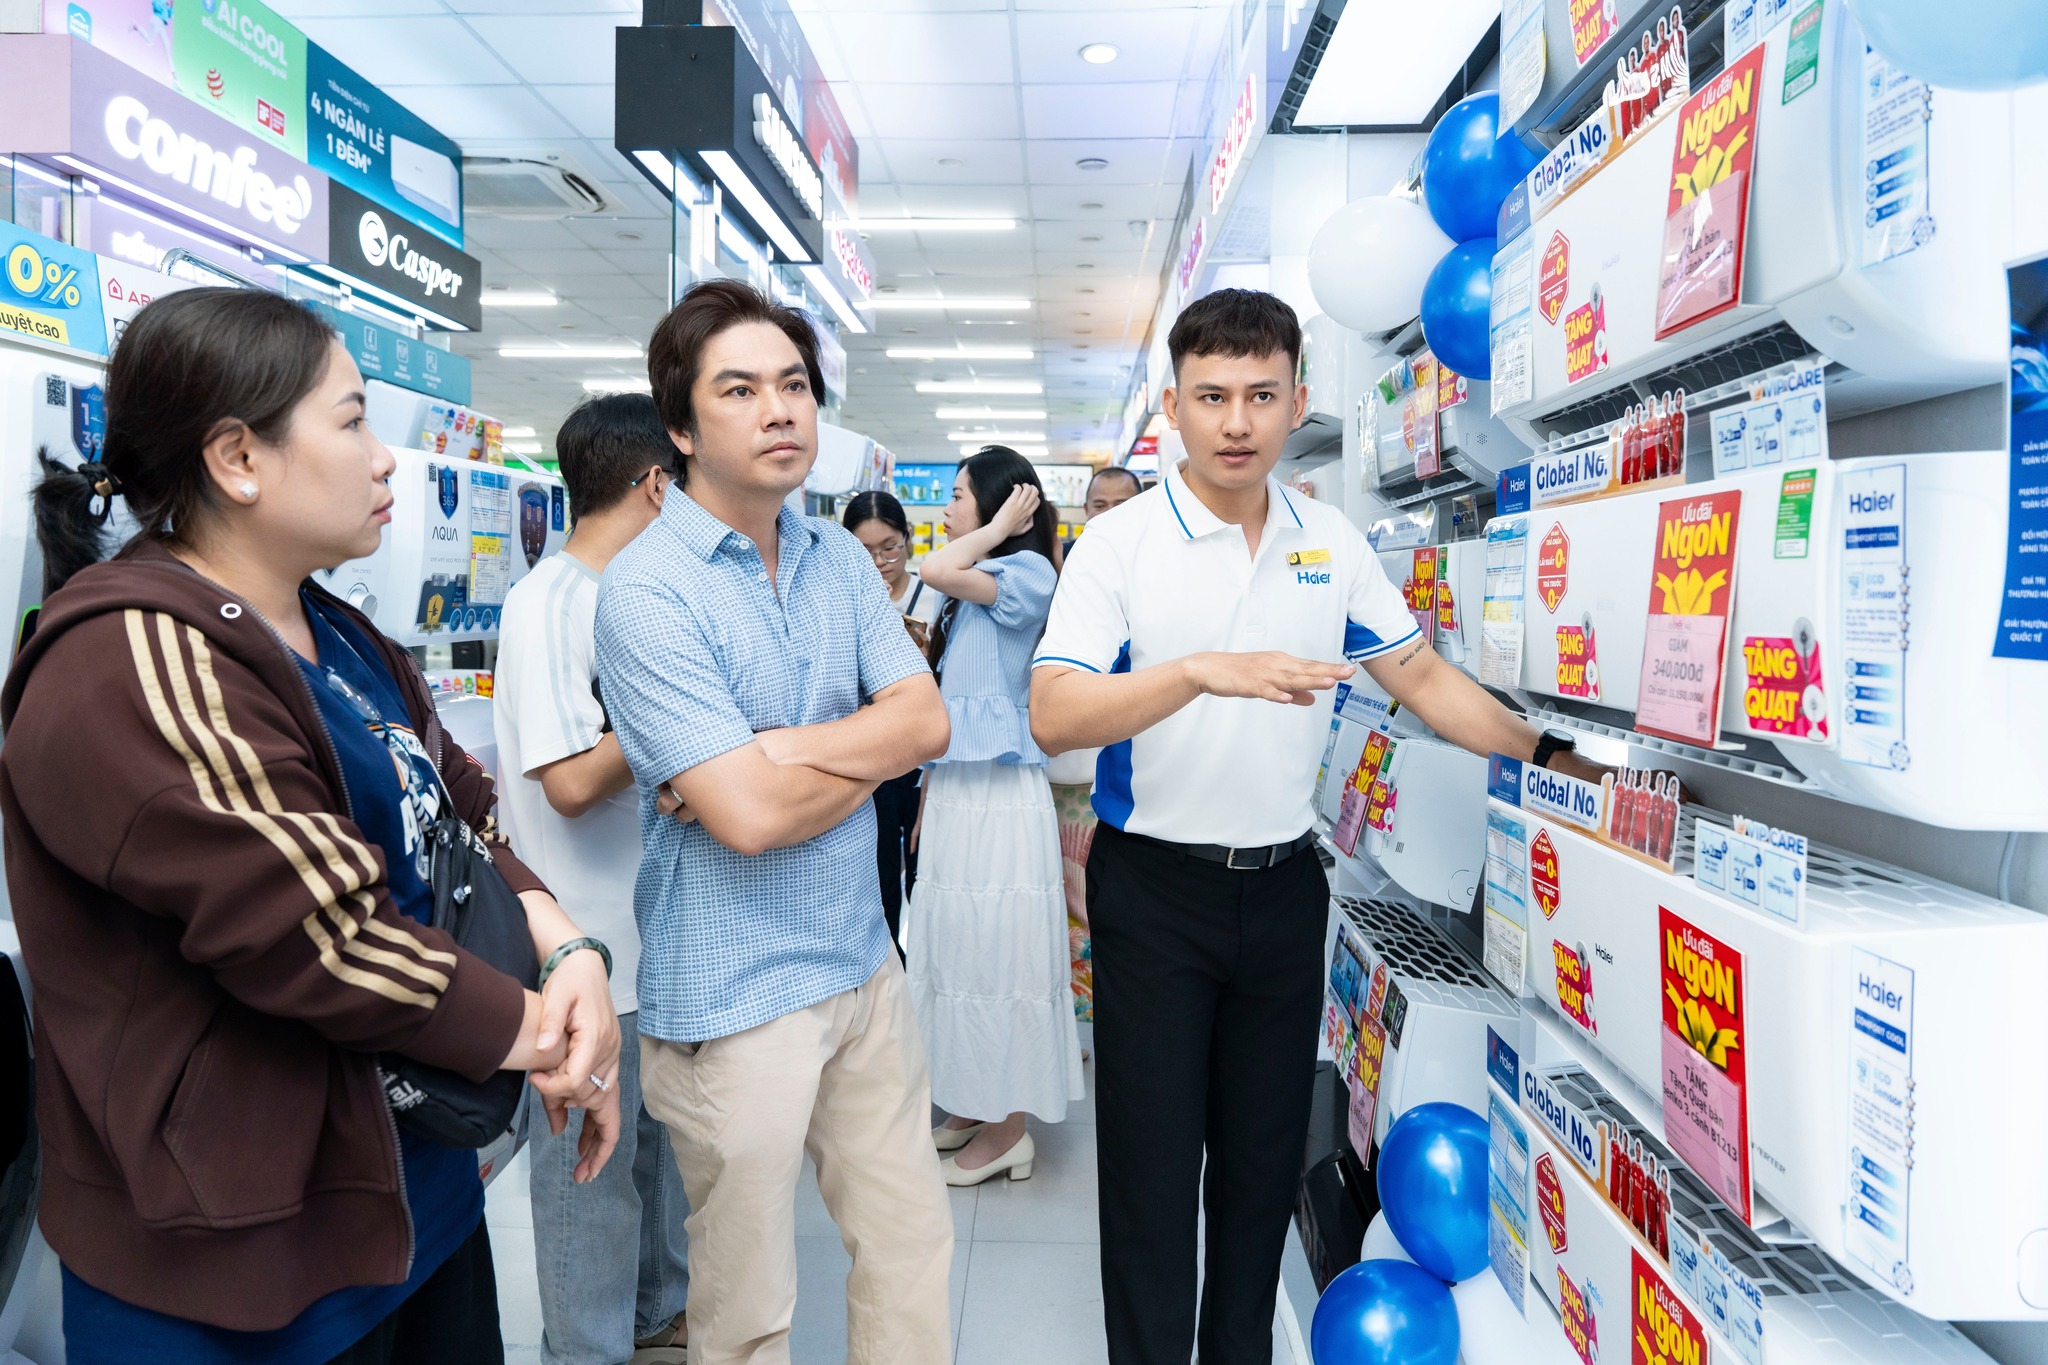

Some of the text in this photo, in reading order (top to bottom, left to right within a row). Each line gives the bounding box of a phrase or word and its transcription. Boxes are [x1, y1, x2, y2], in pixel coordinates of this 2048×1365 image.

[239, 14, 288, 67] COOL
[1574, 9, 1602, 56] QUẠT
[1701, 70, 1734, 110] Ưu đãi
[310, 91, 385, 156] 4 NGÀN LẺ
[326, 132, 333, 154] 1
[1509, 124, 1607, 217] Haier Global No.
[8, 244, 81, 307] 0%
[388, 236, 462, 298] Casper
[35, 320, 60, 339] cao
[1565, 310, 1593, 347] TẶNG
[1566, 341, 1593, 375] QUẠT
[1787, 366, 1823, 392] CARE
[1510, 478, 1526, 493] Haier
[1536, 453, 1579, 491] Global
[1583, 450, 1608, 480] No.
[1682, 500, 1713, 523] Ưu đãi
[1849, 490, 1895, 514] Haier
[432, 526, 458, 541] AQUA
[1297, 571, 1331, 584] Haier
[1556, 627, 1584, 661] TẶNG
[1743, 639, 1798, 686] TẶNG
[1556, 662, 1584, 693] QUẠT
[1744, 686, 1800, 730] QUẠT
[1501, 766, 1518, 785] Haier
[1527, 770, 1569, 808] Global
[1573, 784, 1598, 820] No.
[1769, 830, 1804, 856] CARE
[1553, 943, 1580, 982] TẶNG
[1595, 942, 1614, 965] Haier
[1682, 927, 1714, 961] Ưu đãi
[1555, 976, 1583, 1018] QUẠT
[1858, 972, 1903, 1012] Haier
[1669, 1069, 1724, 1131] Tặng Quạt bàn
[1684, 1064, 1708, 1098] TẶNG
[1499, 1049, 1515, 1076] Haier
[1524, 1070, 1566, 1136] Global
[1571, 1114, 1596, 1168] No.
[1684, 1105, 1690, 1117] 3
[1690, 1111, 1710, 1135] cánh
[1710, 1128, 1738, 1162] B1213
[1557, 1269, 1585, 1323] TẶNG
[1712, 1250, 1763, 1310] VIP CARE
[1655, 1280, 1683, 1328] Ưu đãi
[1560, 1303, 1587, 1356] QUẠT
